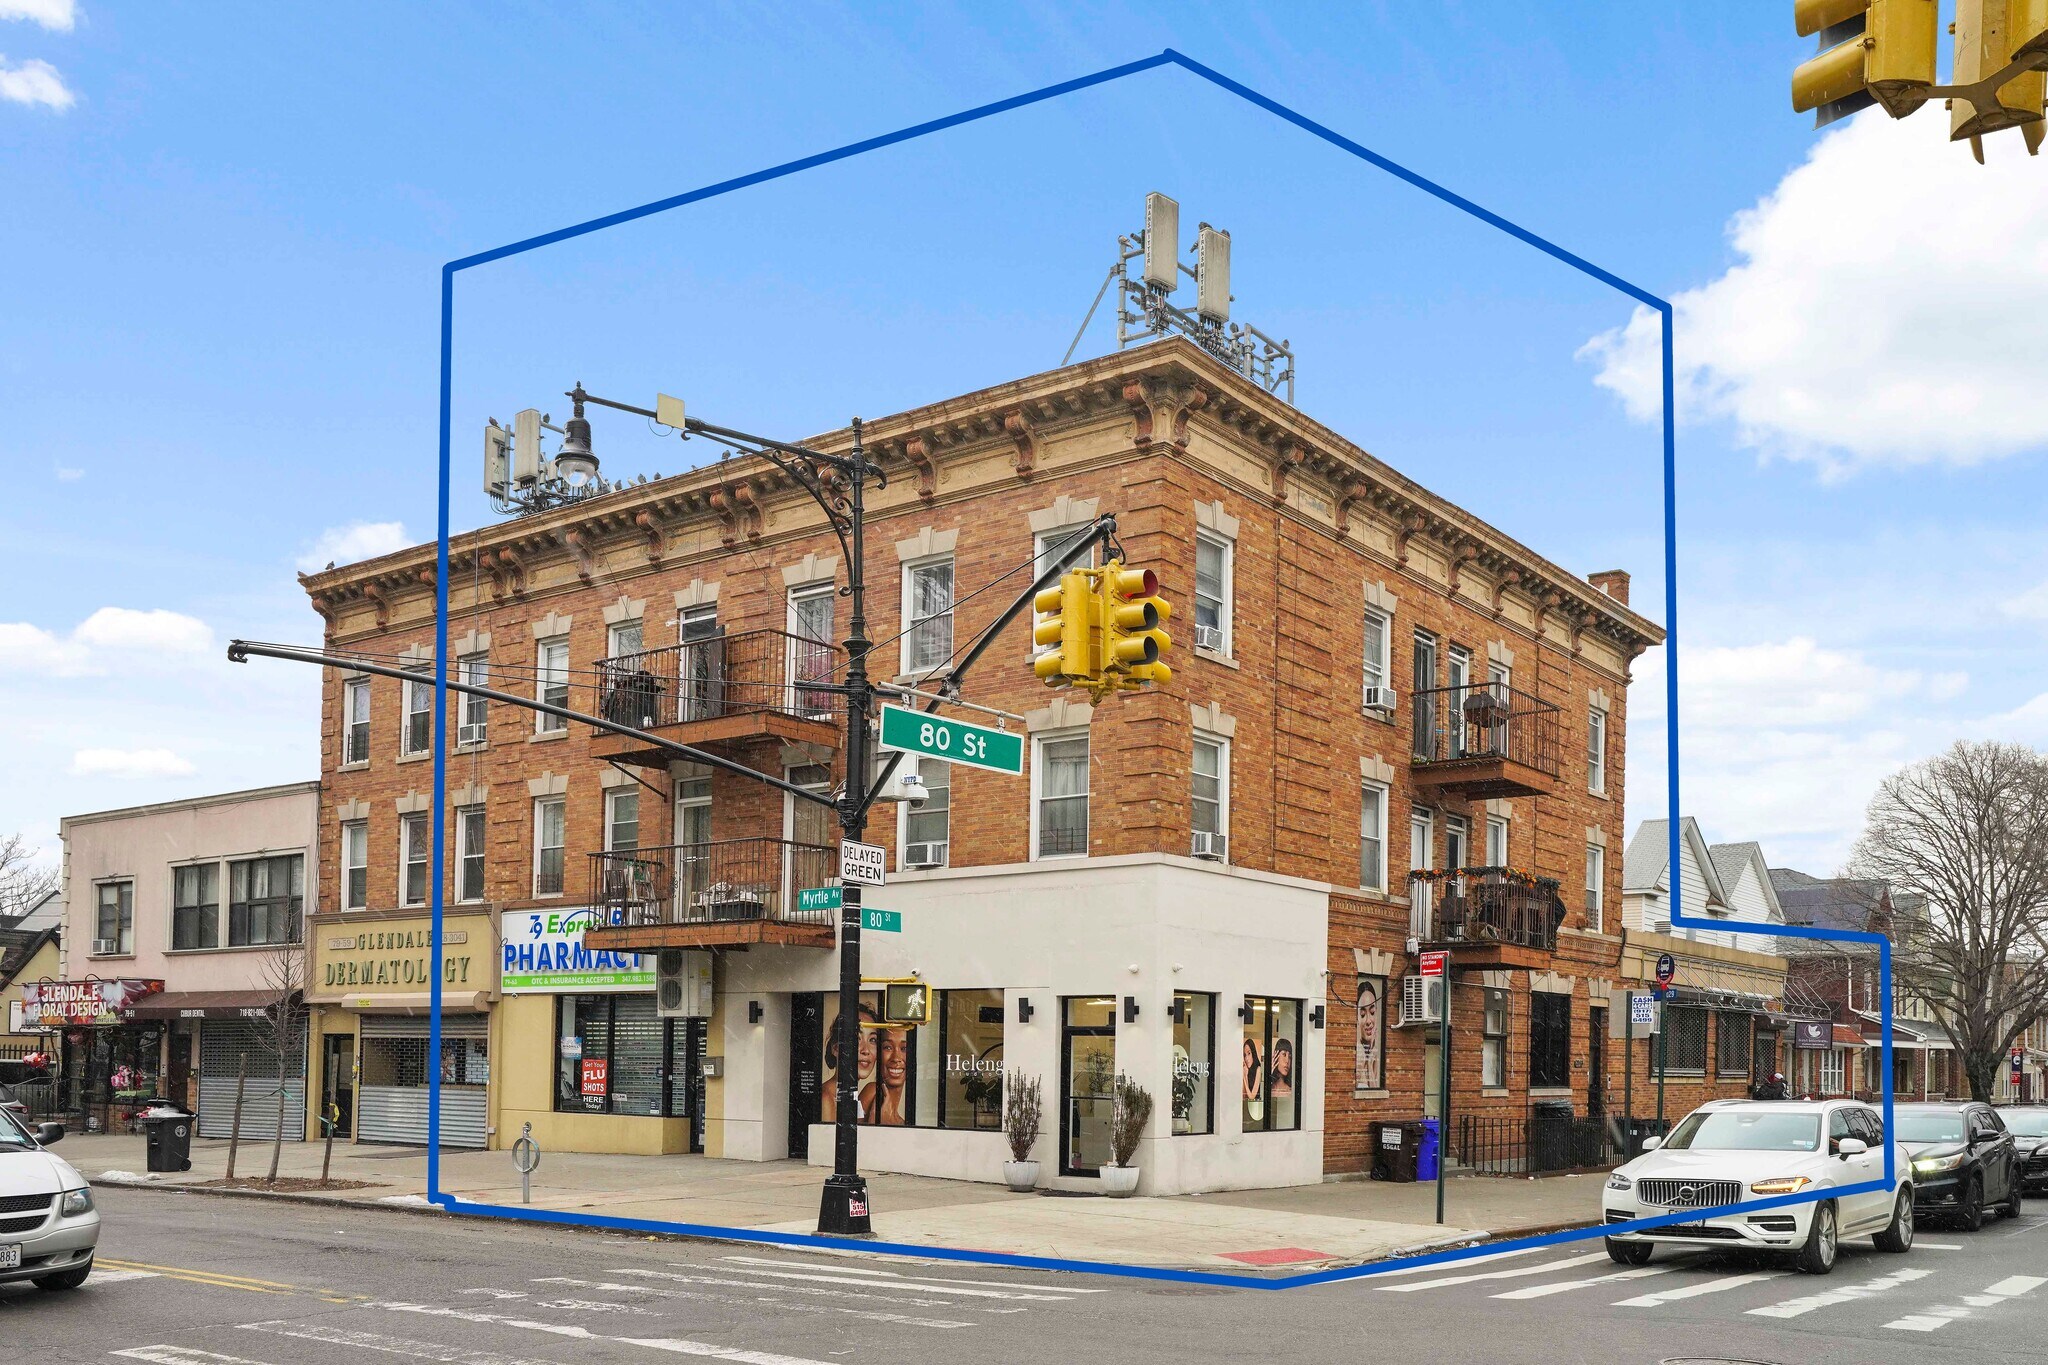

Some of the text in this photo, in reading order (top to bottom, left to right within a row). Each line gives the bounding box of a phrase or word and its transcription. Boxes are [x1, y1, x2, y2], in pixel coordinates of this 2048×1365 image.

[919, 722, 987, 759] 80 St
[843, 845, 882, 865] DELAYED
[844, 862, 881, 880] GREEN
[802, 889, 840, 908] Myrtle Av
[529, 914, 543, 939] 79
[870, 912, 891, 927] 80 St
[325, 956, 471, 985] DERMATOLGY
[531, 977, 543, 985] OTC
[550, 976, 584, 984] INSURANCE
[585, 975, 615, 983] ACCEPTED
[33, 1003, 69, 1017] FLORAL
[70, 1001, 107, 1016] DESIGN
[946, 1054, 1004, 1076] Heleng
[583, 1069, 606, 1081] FLU
[583, 1082, 604, 1092] SHOTS
[583, 1096, 604, 1104] HERE
